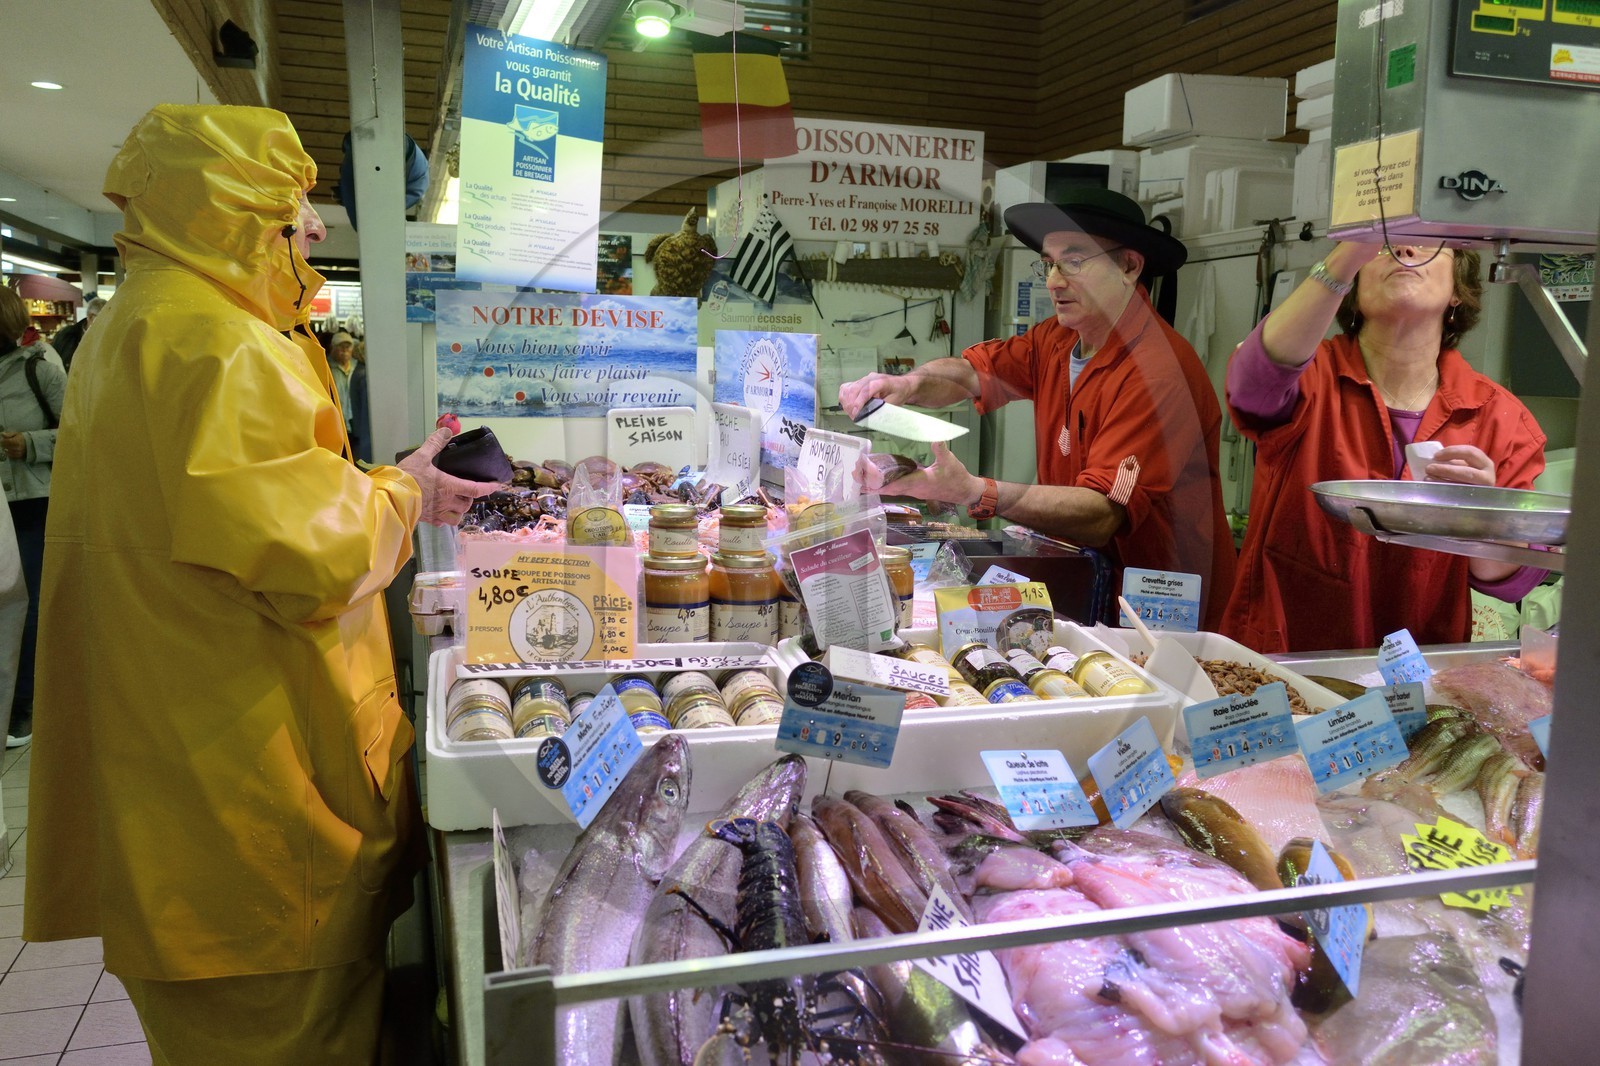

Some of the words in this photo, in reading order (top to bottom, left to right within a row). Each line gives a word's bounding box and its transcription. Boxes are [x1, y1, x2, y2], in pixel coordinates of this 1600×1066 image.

[476, 33, 503, 50] Votre
[507, 41, 542, 58] Artisan
[545, 49, 600, 71] Poissonnier
[506, 61, 531, 74] vous
[533, 66, 572, 82] garantit
[495, 71, 512, 94] la
[517, 78, 580, 107] Qualité
[794, 127, 975, 161] OISSONNERIE
[523, 155, 547, 165] ARTISAN
[516, 162, 552, 173] POISSONNIER
[1361, 168, 1376, 176] vous
[1398, 158, 1411, 168] ceci
[524, 170, 552, 181] BRETAGNE
[810, 160, 941, 190] D'ARMOR
[1388, 172, 1404, 180] dans
[475, 183, 493, 192] Qualité
[1443, 176, 1507, 193] DINA
[1362, 187, 1378, 196] sens
[771, 190, 834, 208] Pierre-Yves
[837, 198, 846, 208] et
[849, 194, 897, 212] Françoise
[901, 197, 973, 215] MORELLI
[473, 212, 492, 222] Qualité
[485, 223, 506, 232] produits
[808, 216, 835, 231] Tél.
[840, 218, 857, 232] 02
[862, 219, 878, 233] 98
[882, 220, 899, 234] 97
[903, 221, 919, 235] 25
[924, 222, 940, 236] 58
[472, 239, 491, 248] Qualité
[472, 305, 563, 327] NOTRE
[571, 308, 665, 329] DEVISE
[721, 313, 757, 323] Saumon
[758, 313, 802, 324] écossais
[475, 338, 516, 354] Vous
[521, 339, 558, 356] bien
[563, 341, 612, 356] servir
[507, 363, 546, 379] Vous
[549, 364, 592, 382] faire
[596, 364, 650, 383] plaisir
[541, 388, 581, 403] Vous
[584, 388, 618, 404] voir
[622, 387, 681, 404] revenir
[615, 414, 668, 429] PLEINE
[628, 429, 683, 447] SAISON
[664, 537, 692, 546] Rouille
[532, 556, 550, 565] BEST
[551, 557, 591, 566] SELECTION
[800, 563, 820, 574] Salade
[820, 560, 828, 568] du
[471, 567, 521, 580] SOUPE
[554, 572, 591, 580] POISSONS
[1142, 576, 1166, 584] Crevettes
[532, 578, 576, 586] ARTISANALE
[1021, 588, 1044, 601] 1,95
[647, 619, 681, 635] Soupe
[725, 617, 762, 632] Soupe
[892, 666, 944, 685] SAUCES
[832, 691, 861, 702] Merlan
[1385, 694, 1396, 702] ouget
[834, 709, 856, 718] Atlantique
[1213, 706, 1229, 716] Raie
[1230, 698, 1258, 712] bouclée
[1230, 717, 1250, 726] Atlantique
[1328, 711, 1356, 728] Limande
[577, 722, 592, 742] Merlu
[1340, 727, 1358, 737] Atlantique
[1006, 760, 1026, 768] Queue
[1027, 760, 1035, 768] de
[1035, 760, 1049, 768] lotte
